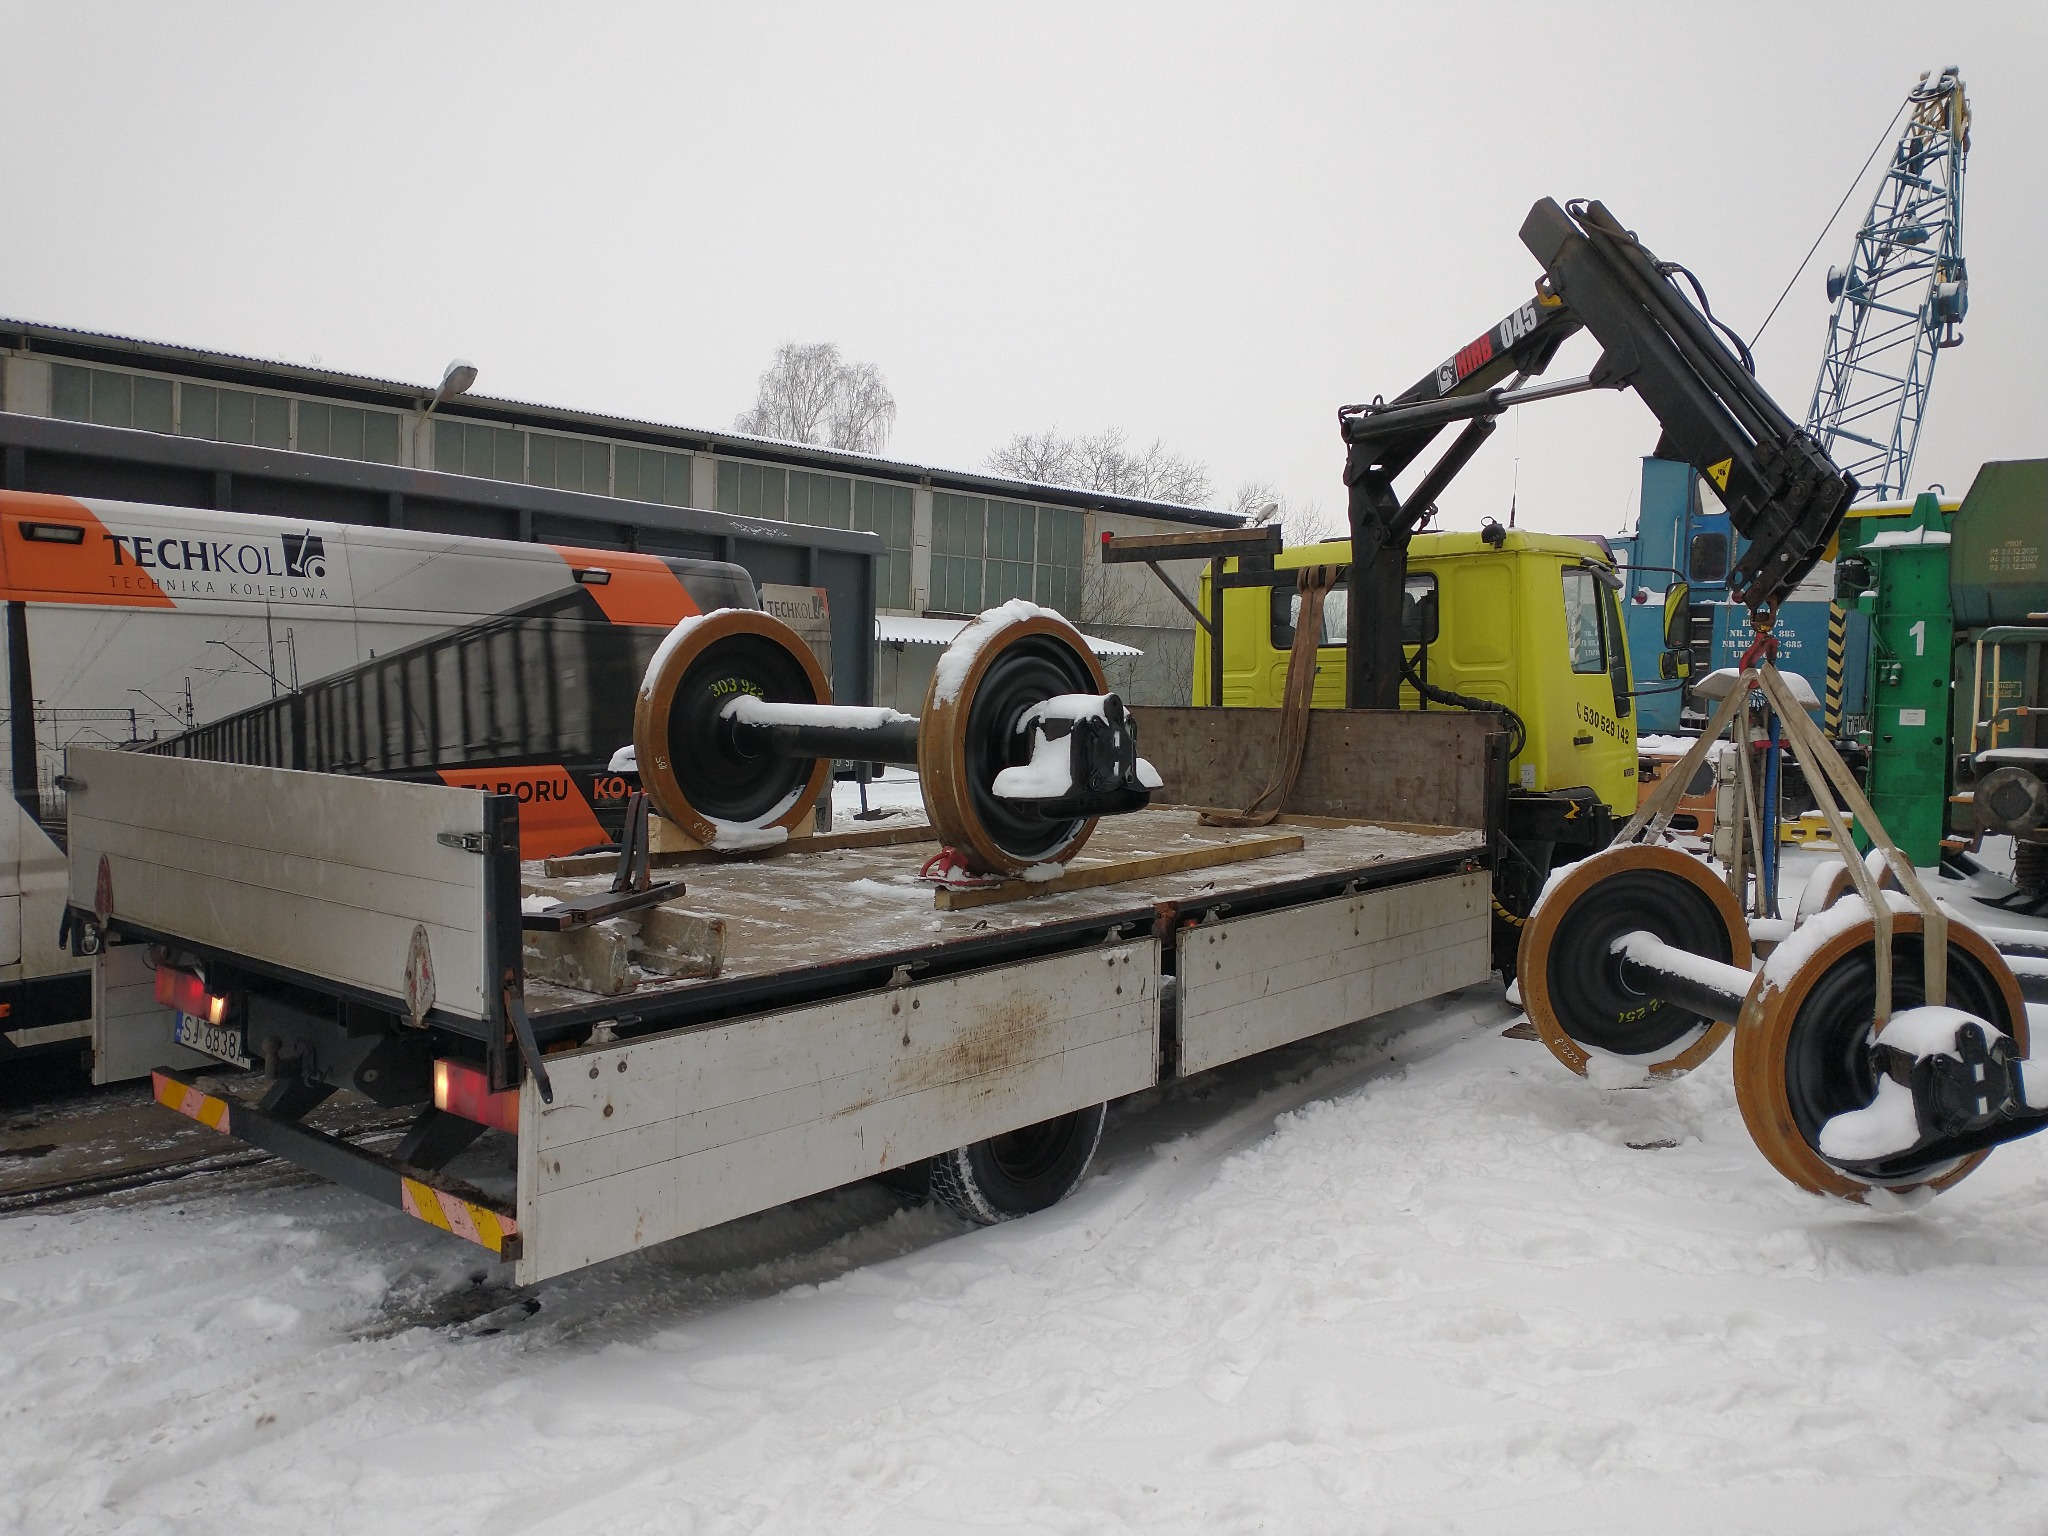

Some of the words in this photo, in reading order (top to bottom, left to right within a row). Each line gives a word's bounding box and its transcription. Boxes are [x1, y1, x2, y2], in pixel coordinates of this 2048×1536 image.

[1455, 333, 1493, 379] HIAB
[1500, 301, 1537, 348] 045
[102, 534, 283, 577] TECHKOL
[108, 575, 215, 593] TECHNIKA
[230, 582, 328, 599] KOLEJOWA
[766, 600, 814, 620] TECHKOL
[1909, 621, 1926, 656] 1
[1583, 706, 1600, 729] 530
[1600, 715, 1615, 737] 529
[1616, 725, 1629, 745] 142
